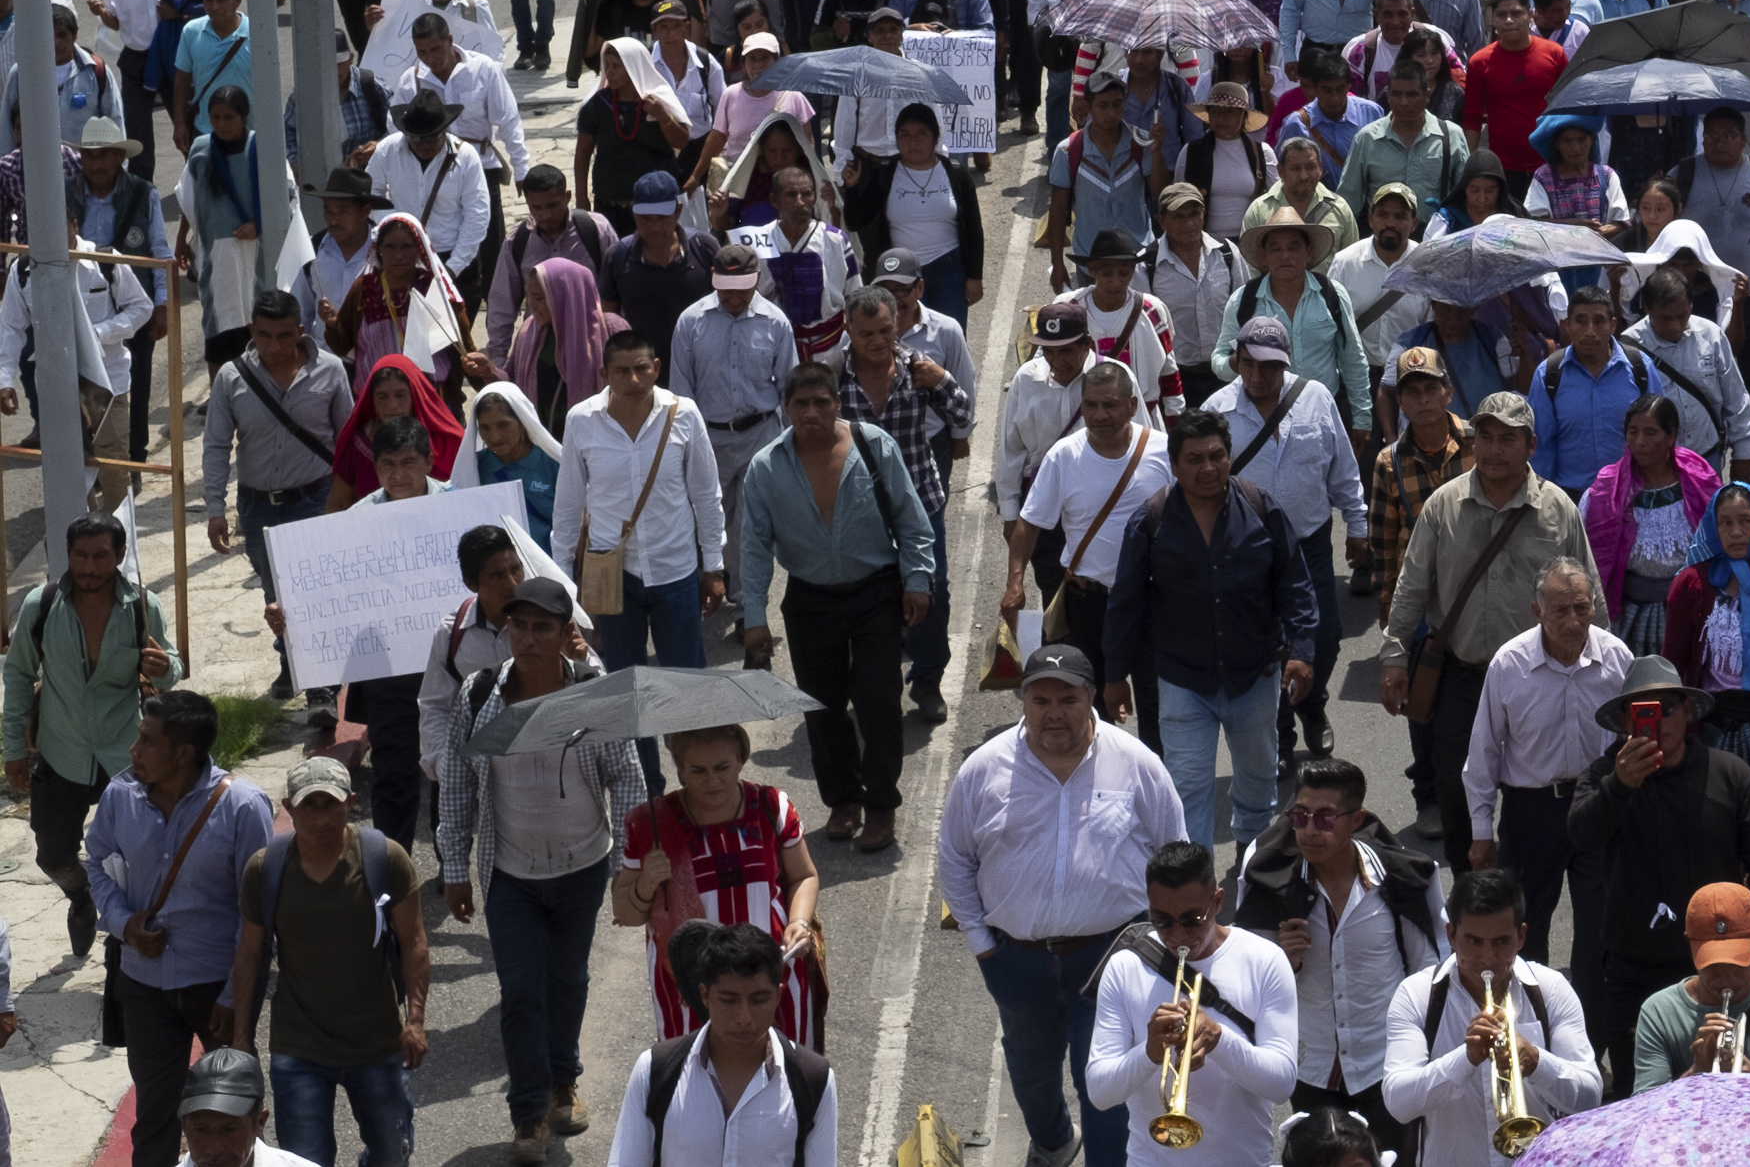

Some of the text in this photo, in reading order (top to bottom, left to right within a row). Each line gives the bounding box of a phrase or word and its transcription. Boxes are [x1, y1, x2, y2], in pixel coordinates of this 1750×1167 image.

[955, 49, 974, 67] SER
[974, 85, 991, 101] NO
[961, 116, 971, 133] EL
[949, 132, 994, 148] JUSTICIA
